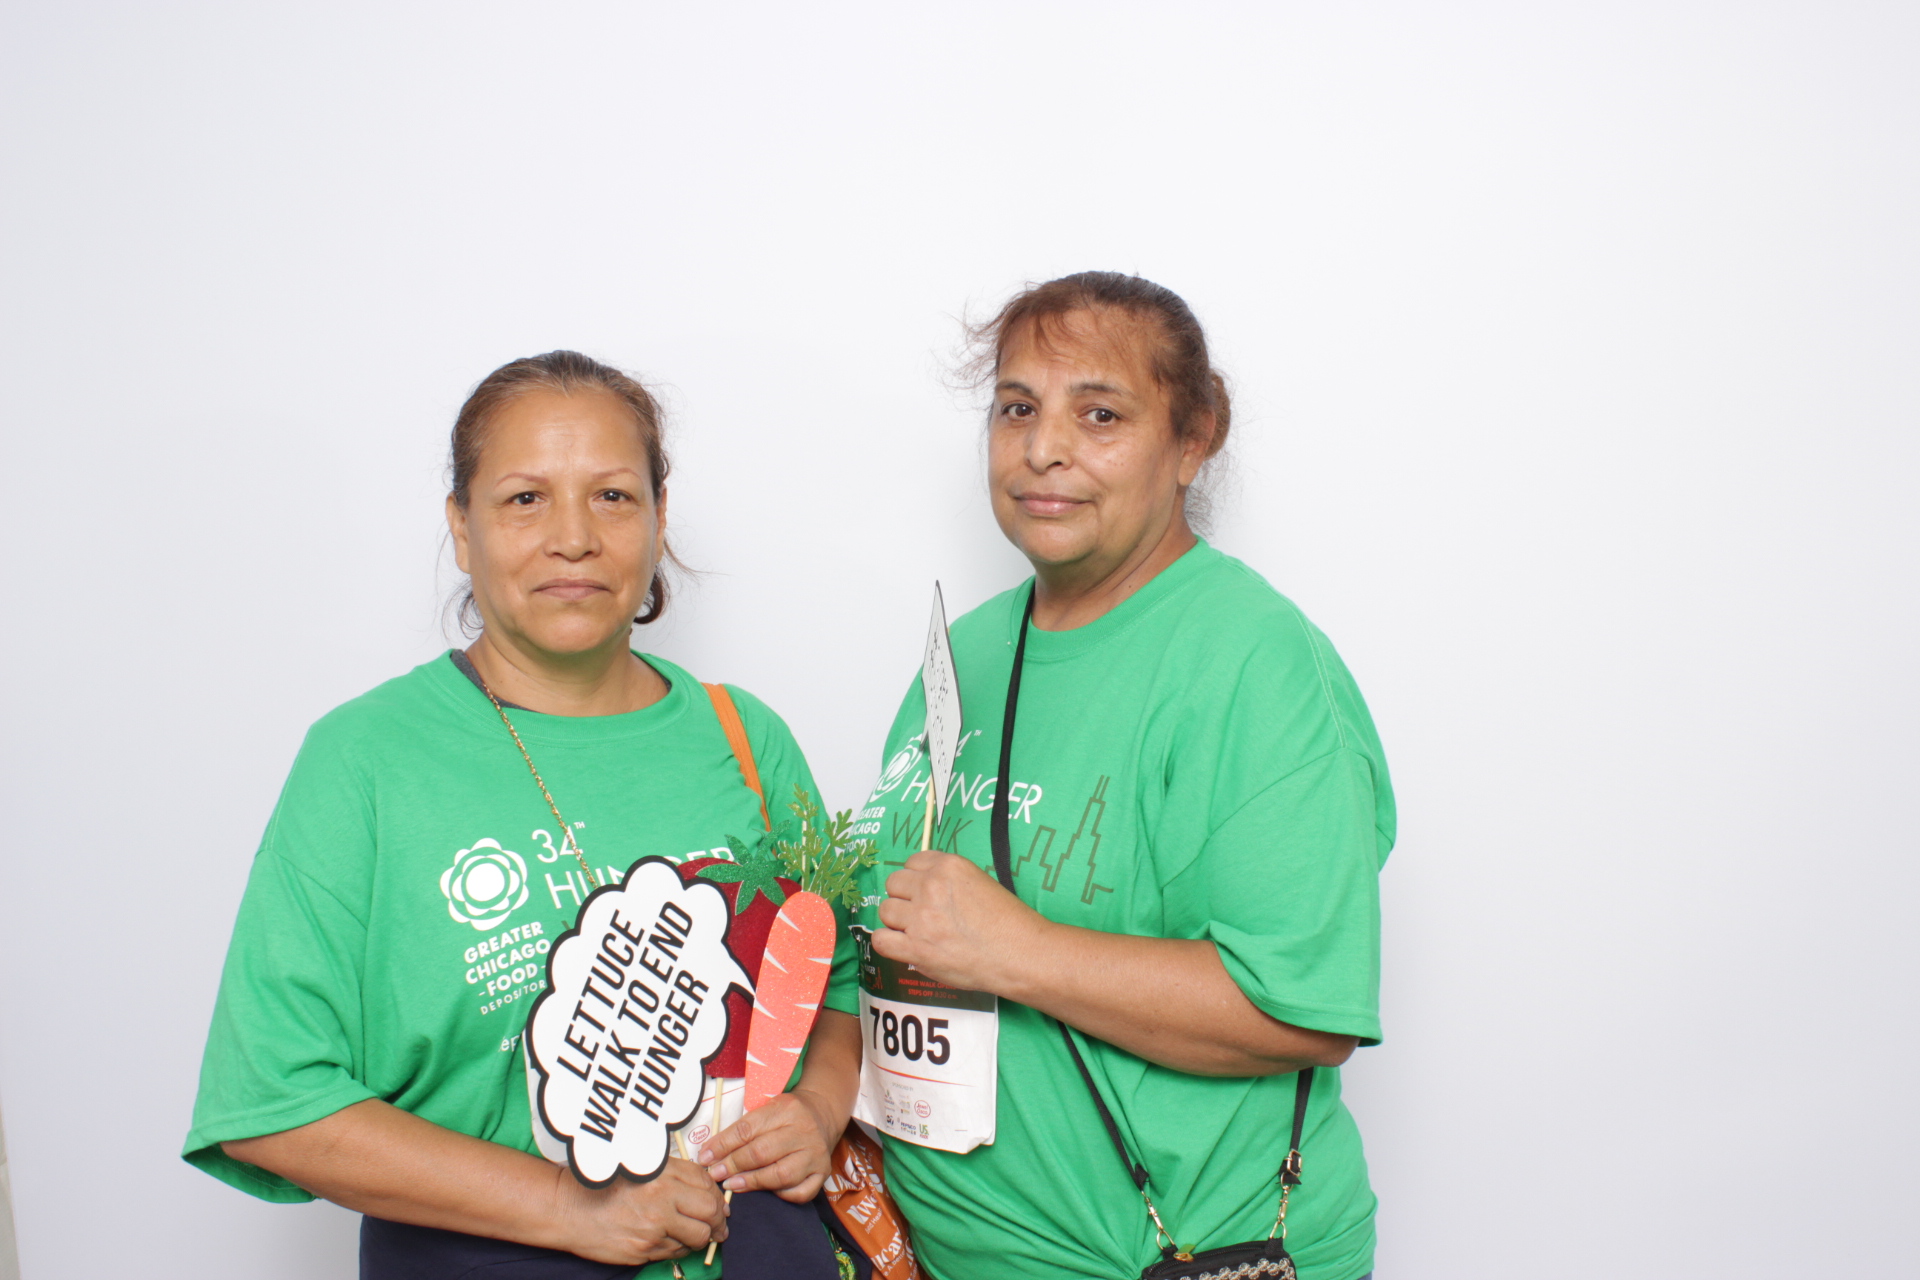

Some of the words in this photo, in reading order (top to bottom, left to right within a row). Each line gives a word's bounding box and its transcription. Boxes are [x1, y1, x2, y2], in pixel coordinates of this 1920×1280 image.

[900, 769, 1042, 824] HNGER
[464, 921, 544, 963] GREATER
[465, 938, 551, 984] CHICAGO
[486, 963, 538, 997] FOOD
[556, 908, 645, 1082] LETTUCE
[579, 1029, 642, 1143] WALK
[616, 979, 660, 1032] TO
[638, 901, 694, 984] END
[629, 969, 709, 1122] HUNGER
[869, 1005, 951, 1065] 7805
